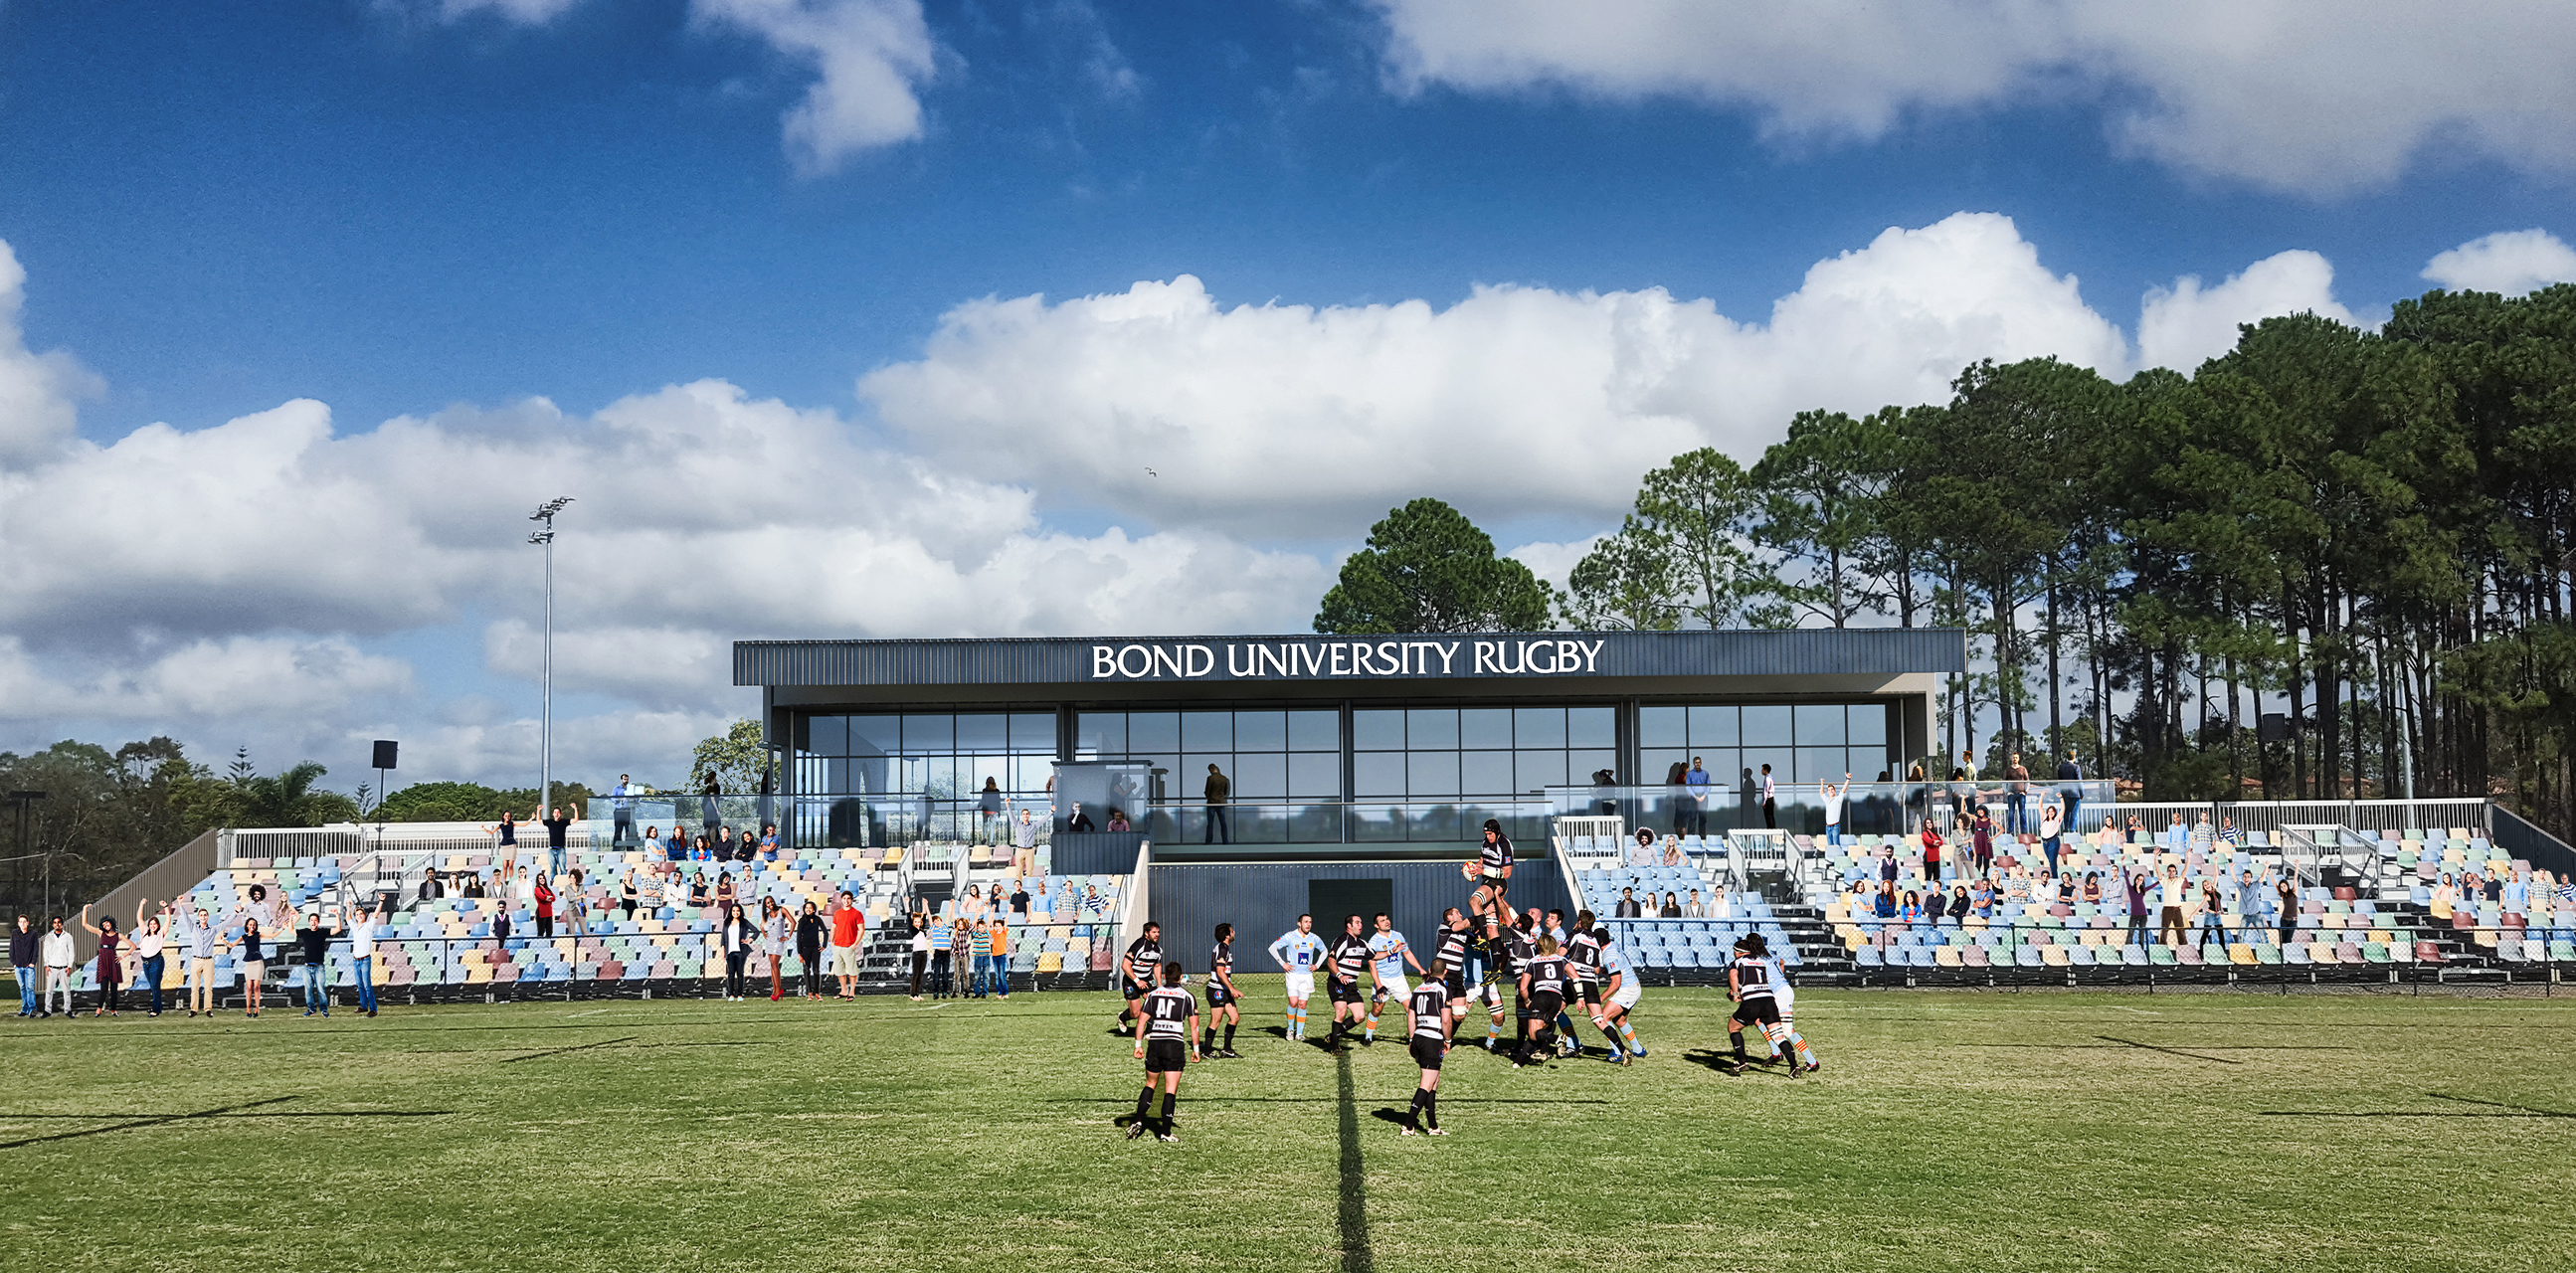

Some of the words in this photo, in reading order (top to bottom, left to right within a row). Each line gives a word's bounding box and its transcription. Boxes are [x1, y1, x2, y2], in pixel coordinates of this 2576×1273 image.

[1092, 644, 1214, 678] BOND
[1227, 641, 1460, 676] UNIVERSITY
[1474, 639, 1605, 674] RUGBY
